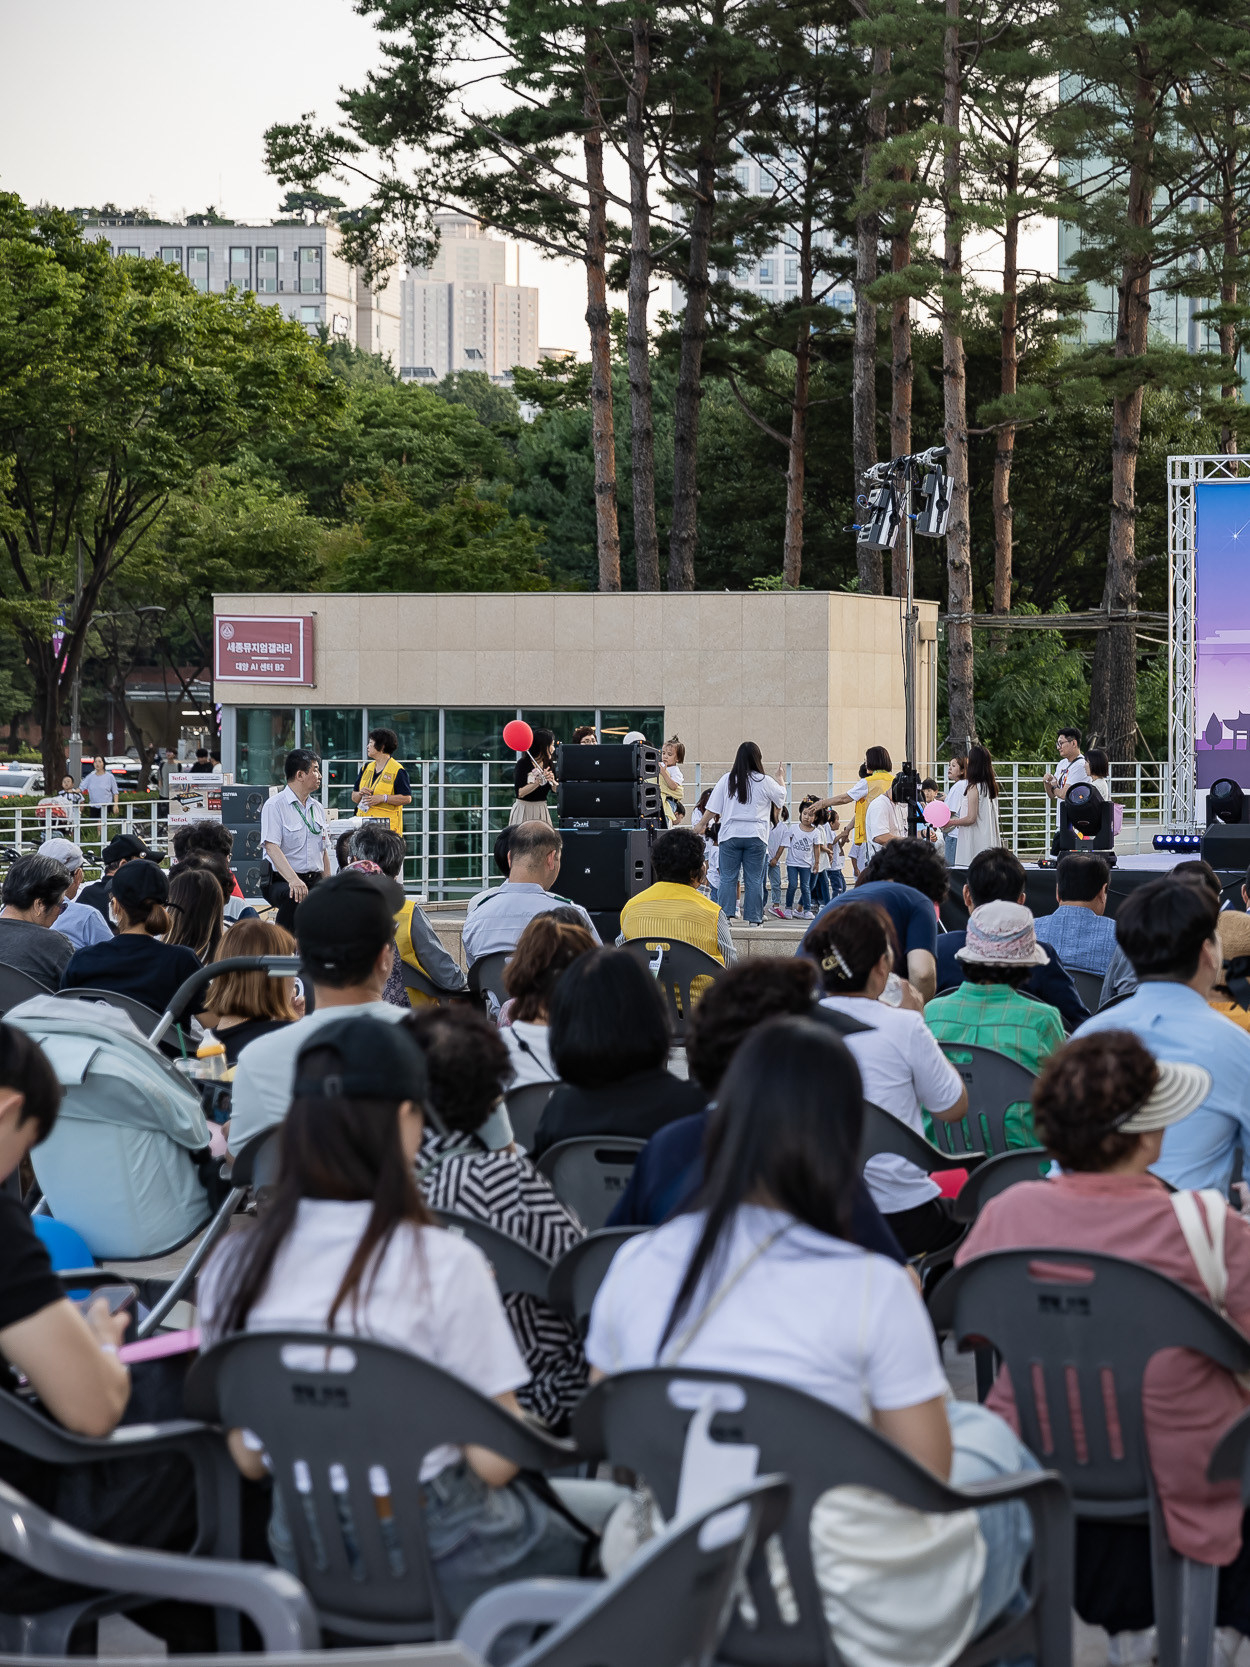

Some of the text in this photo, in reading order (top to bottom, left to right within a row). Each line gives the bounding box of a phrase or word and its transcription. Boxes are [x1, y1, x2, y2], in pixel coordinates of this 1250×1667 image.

[226, 642, 293, 654] 세종뮤지엄갤러리
[235, 662, 285, 672] 대양 AI 센터 B2
